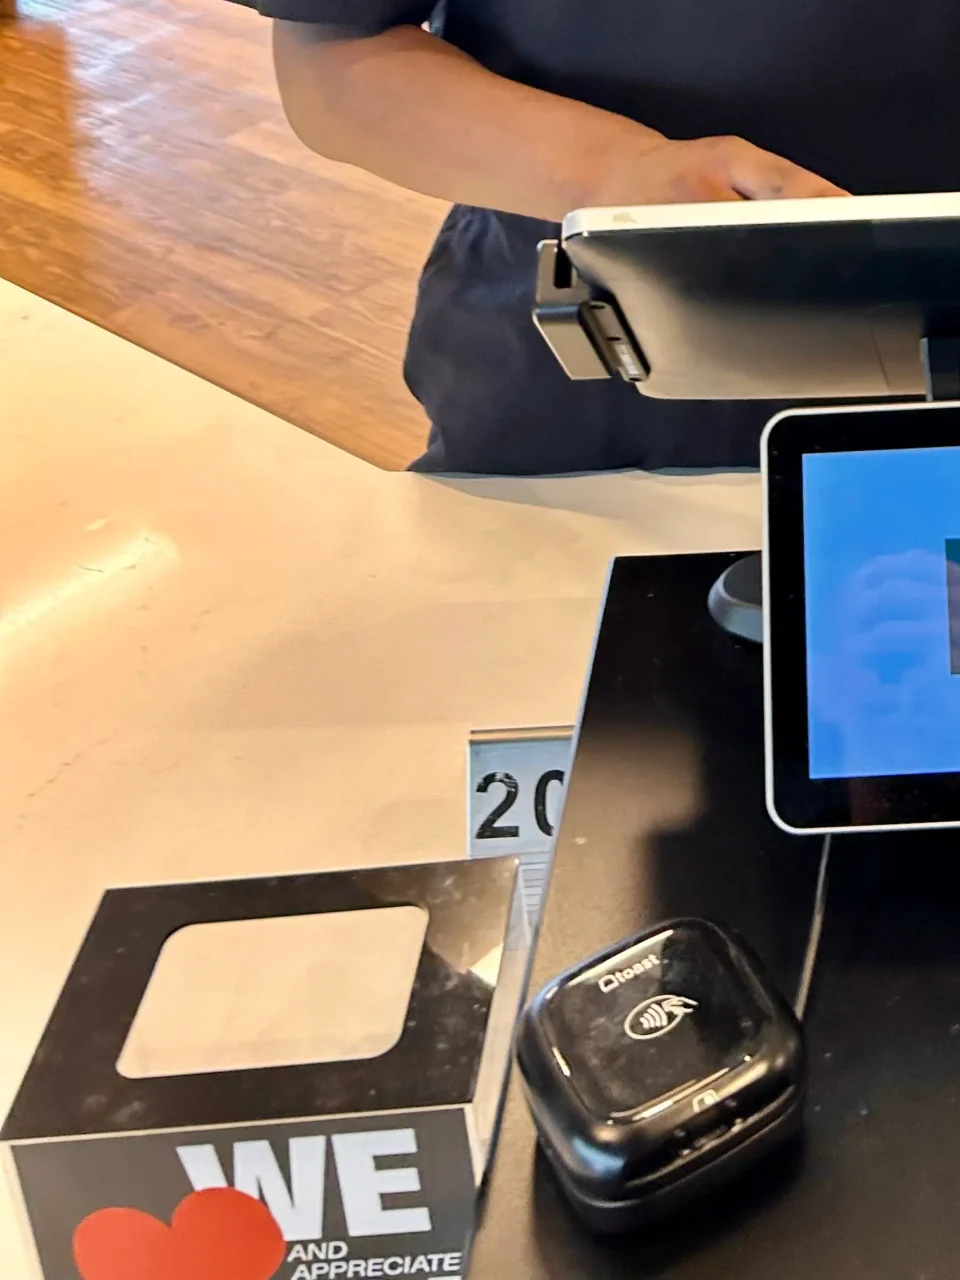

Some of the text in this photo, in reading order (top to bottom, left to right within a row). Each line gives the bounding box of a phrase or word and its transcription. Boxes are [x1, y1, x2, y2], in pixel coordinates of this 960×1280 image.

[616, 954, 659, 983] toast
[176, 1128, 431, 1241] WE
[287, 1241, 348, 1262] AND
[290, 1252, 462, 1280] APPRECIATE
